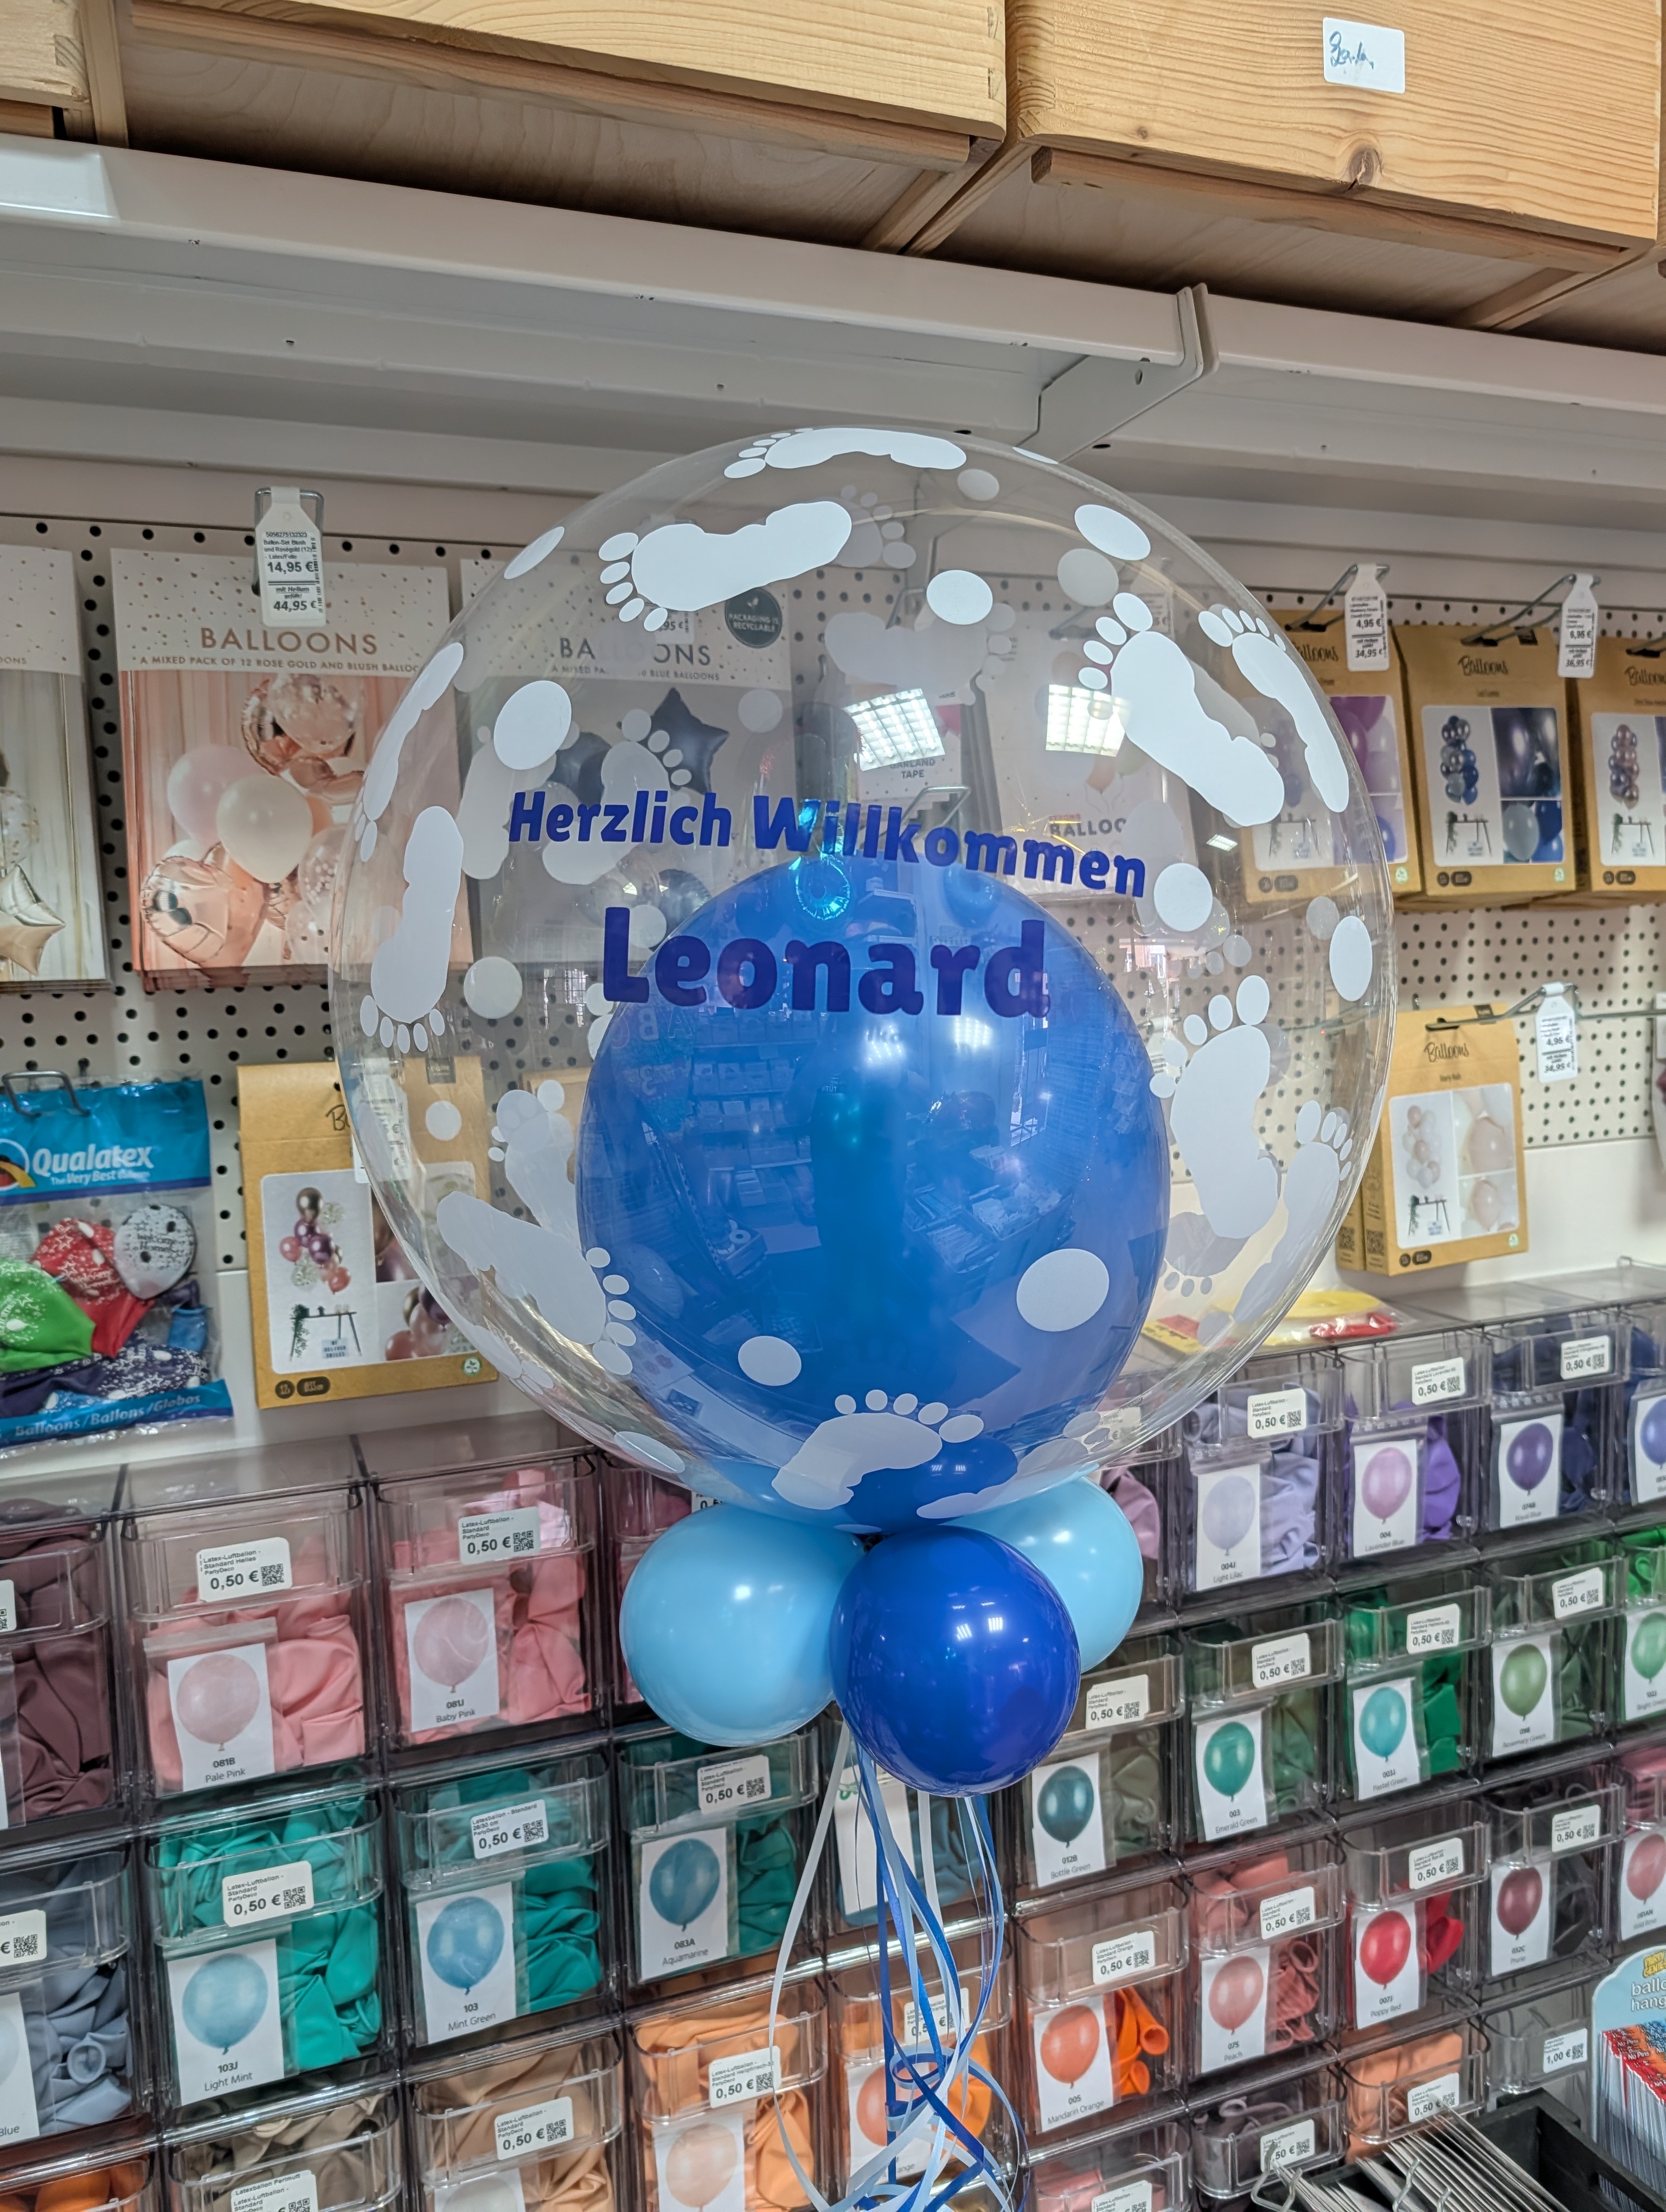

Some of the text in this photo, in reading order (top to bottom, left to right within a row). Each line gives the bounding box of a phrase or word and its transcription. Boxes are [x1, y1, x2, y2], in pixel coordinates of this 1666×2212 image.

[267, 561, 314, 574] 14,95 €
[273, 600, 317, 613] 44,95 €
[201, 627, 377, 655] BALLOONS
[152, 656, 185, 665] MIXED
[190, 657, 217, 665] PACK
[221, 658, 236, 666] OF
[241, 659, 252, 667] 12
[257, 659, 283, 668] ROSE
[287, 660, 317, 669] GOLD
[321, 660, 343, 670] AND
[347, 662, 379, 671] BLUSH
[901, 770, 925, 779] TAPE
[508, 790, 1146, 898] Herzlich Willkommen
[603, 906, 1052, 1020] Leonard
[1424, 1041, 1470, 1063] Balloons
[33, 1143, 155, 1178] Qualatex
[66, 1172, 92, 1186] Very
[1566, 1359, 1584, 1371] 0,50
[1418, 1380, 1446, 1397] 0,50 €
[1255, 1414, 1285, 1430] 0,50 €
[462, 1516, 510, 1528] Latex-Luftballon
[462, 1525, 490, 1534] Standard
[467, 1536, 511, 1555] 0,50 €
[203, 1549, 257, 1563] Latex-Luftballon
[204, 1560, 234, 1569] Standard
[204, 1566, 234, 1575] PartyDeco
[210, 1570, 259, 1590] 0,50 €
[1213, 1574, 1228, 1583] Light
[1560, 1593, 1585, 1609] 0,50 €
[1412, 1632, 1440, 1647] 0,50 €
[1260, 1663, 1290, 1680] 0,50 €
[436, 1708, 476, 1723] Baby Pink
[1091, 1706, 1123, 1721] 0,50 €
[213, 1757, 236, 1768] 081B
[205, 1767, 246, 1783] Pale Pink
[1373, 1777, 1407, 1792] Pastel Green
[706, 1784, 745, 1803] 0,50 €
[510, 1803, 537, 1815] Standard
[1229, 1809, 1240, 1817] 003
[1215, 1817, 1257, 1833] Emerald Green
[479, 1827, 522, 1849] 0,50 €
[1556, 1830, 1574, 1842] 0,50
[1050, 1863, 1091, 1879] Bottle Green
[1418, 1863, 1445, 1881] 0,50 €
[227, 1874, 279, 1891] Latex-Luftballon
[227, 1886, 258, 1896] Standard
[228, 1892, 258, 1902] PartyDeco
[234, 1894, 281, 1915] 0,50 €
[1265, 1913, 1295, 1932] 0,50 €
[1, 1941, 11, 1954] €
[1100, 1956, 1132, 1975] 0,50 €
[463, 2002, 479, 2012] 103
[1379, 1995, 1393, 2004] 007J
[1370, 2004, 1401, 2017] Poppy Red
[448, 2013, 496, 2031] Mint Green
[939, 2016, 946, 2027] €
[1547, 2049, 1571, 2064] 1,00 €
[217, 2061, 238, 2073] 103J
[204, 2072, 253, 2091] Light Mint
[716, 2079, 754, 2099] 0,50 €
[1068, 2094, 1081, 2105] 005
[1047, 2100, 1105, 2125] Mandarin Orange
[1414, 2102, 1433, 2116] 0,50
[497, 2121, 524, 2133] Standard
[498, 2127, 524, 2138] PartyDeco
[503, 2128, 544, 2150] 0,50 €
[1289, 2145, 1295, 2155] €
[235, 2173, 300, 2196] Latexballon Perlmutt
[233, 2188, 285, 2206] Latex-Luftballon
[234, 2199, 264, 2211] Standard
